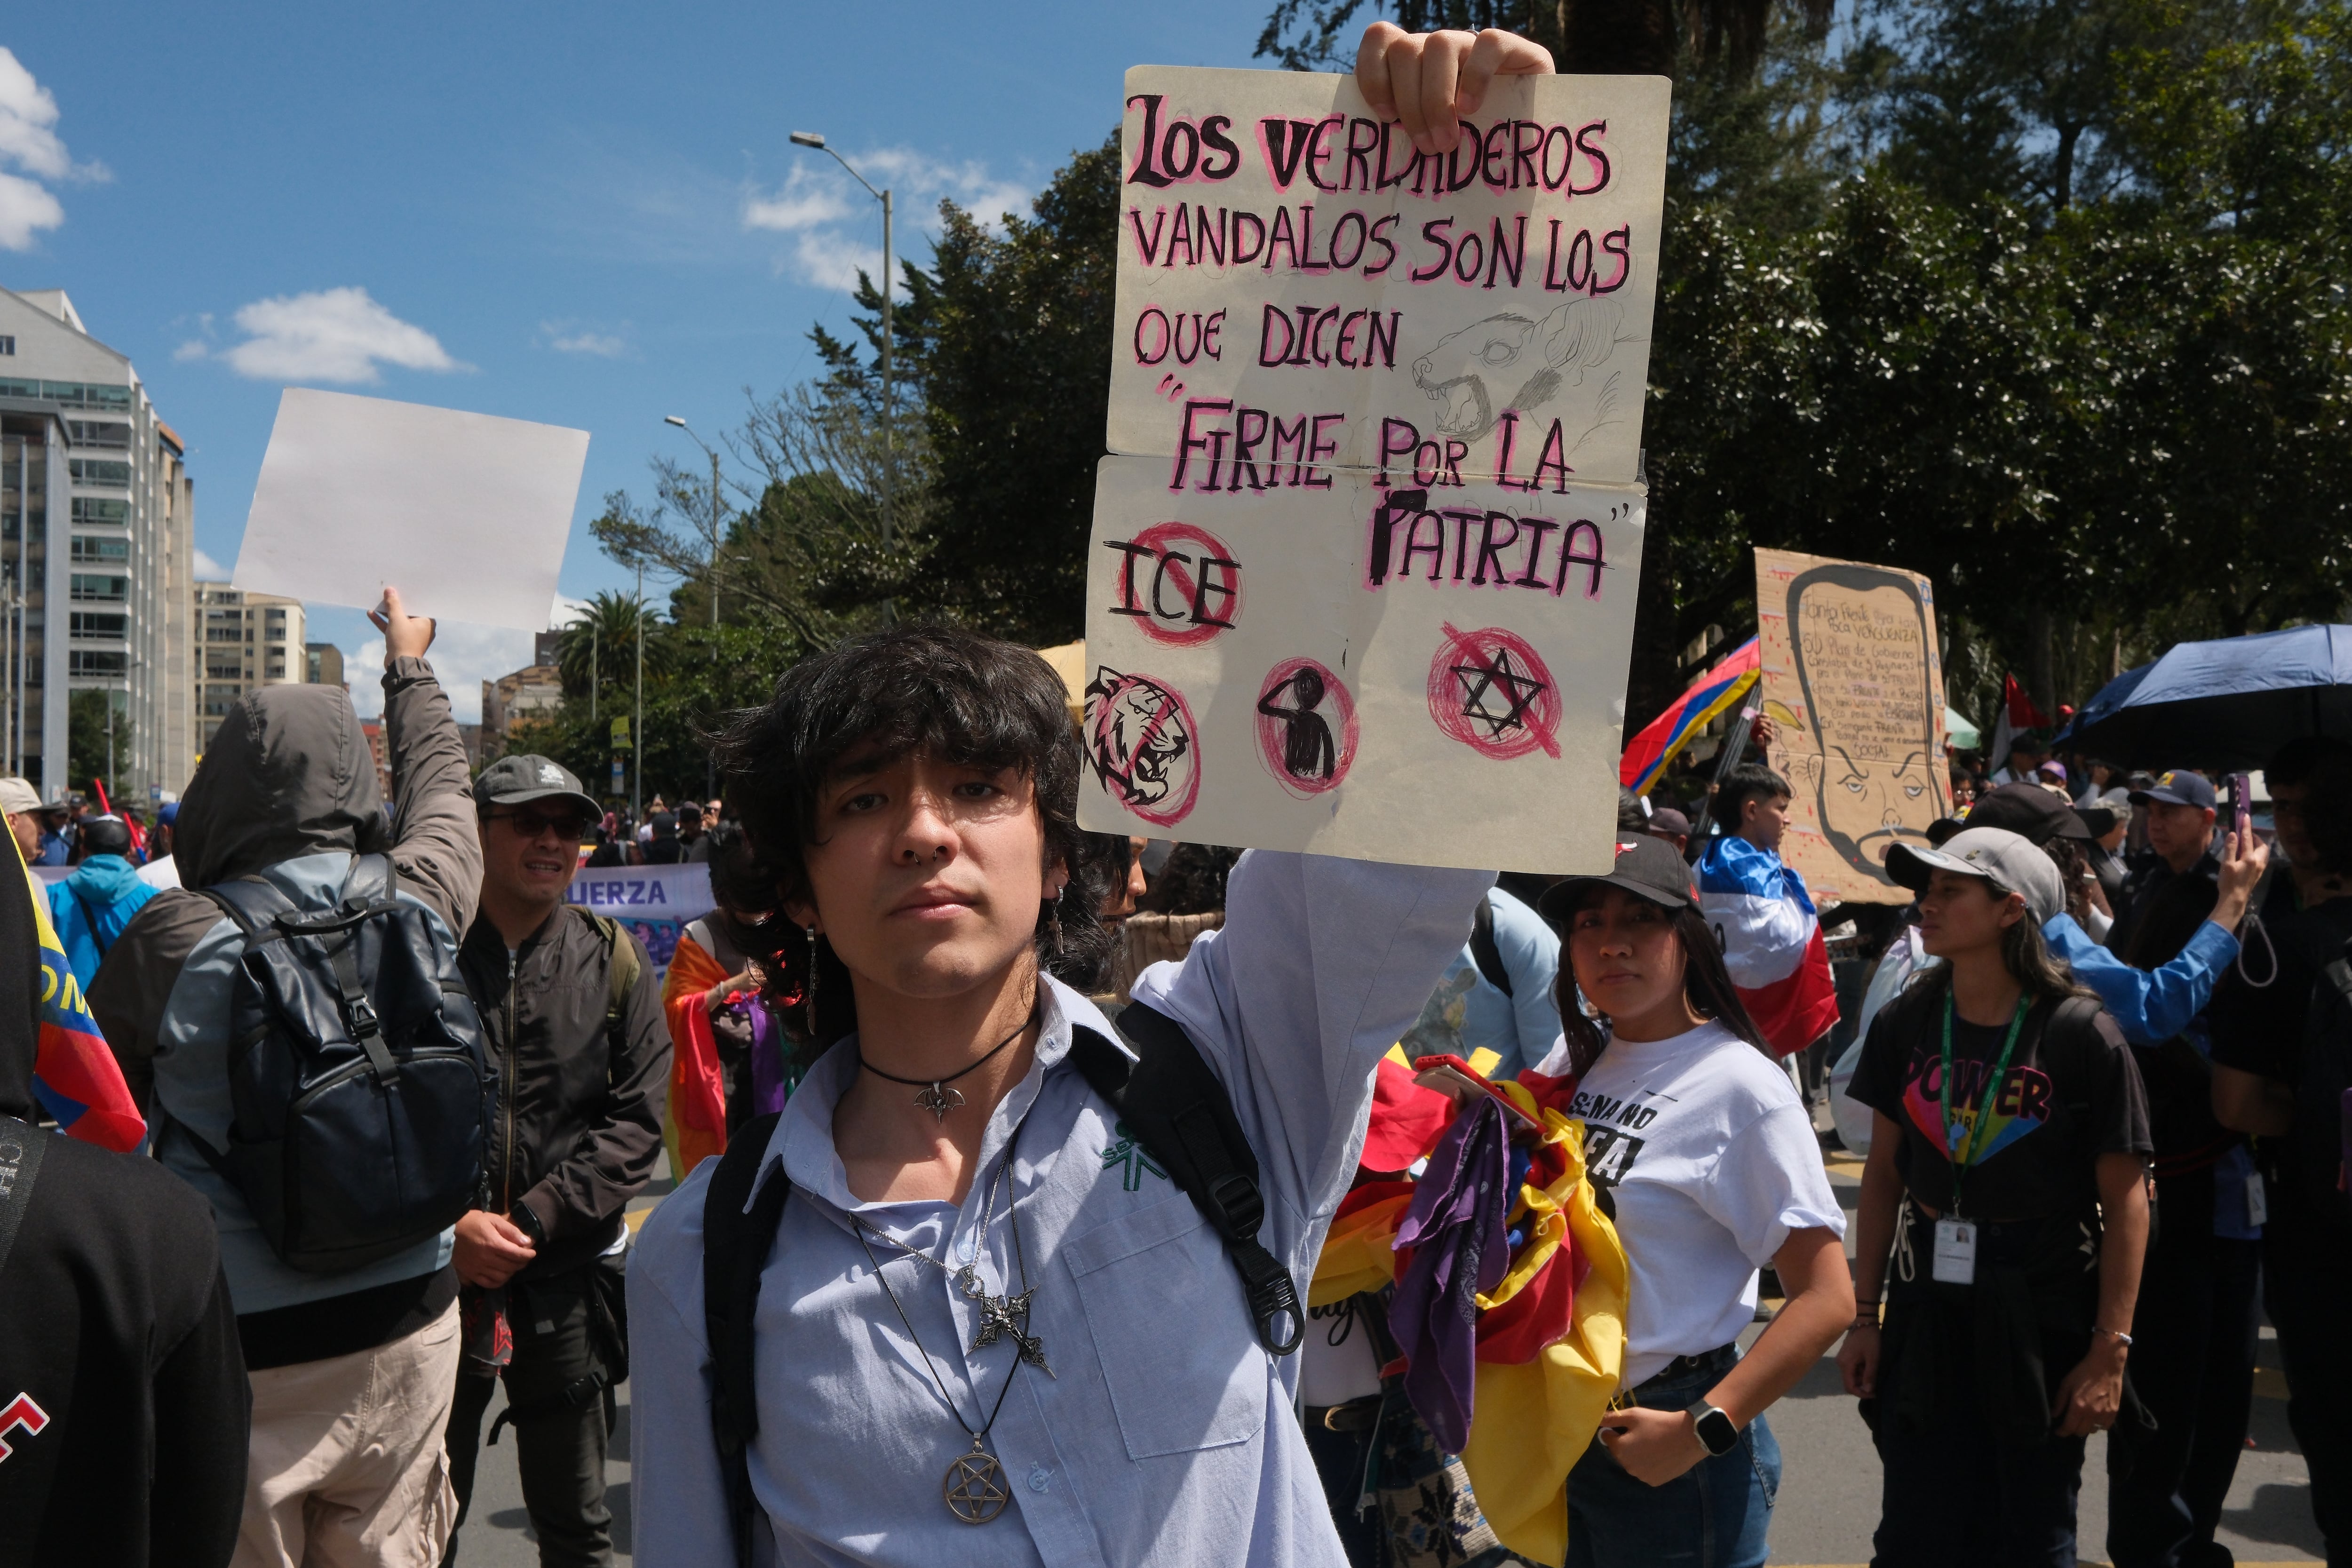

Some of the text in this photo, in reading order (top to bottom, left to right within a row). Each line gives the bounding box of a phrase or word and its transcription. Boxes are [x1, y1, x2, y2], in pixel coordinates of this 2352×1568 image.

[1128, 94, 1612, 196] LOS VERDADEROS
[1130, 202, 1630, 295] VANDALOS SON LOS
[1135, 304, 1403, 369] QUE DICEN
[1379, 417, 1469, 486] POR
[1499, 414, 1573, 494] LA
[1103, 540, 1243, 629] ICE
